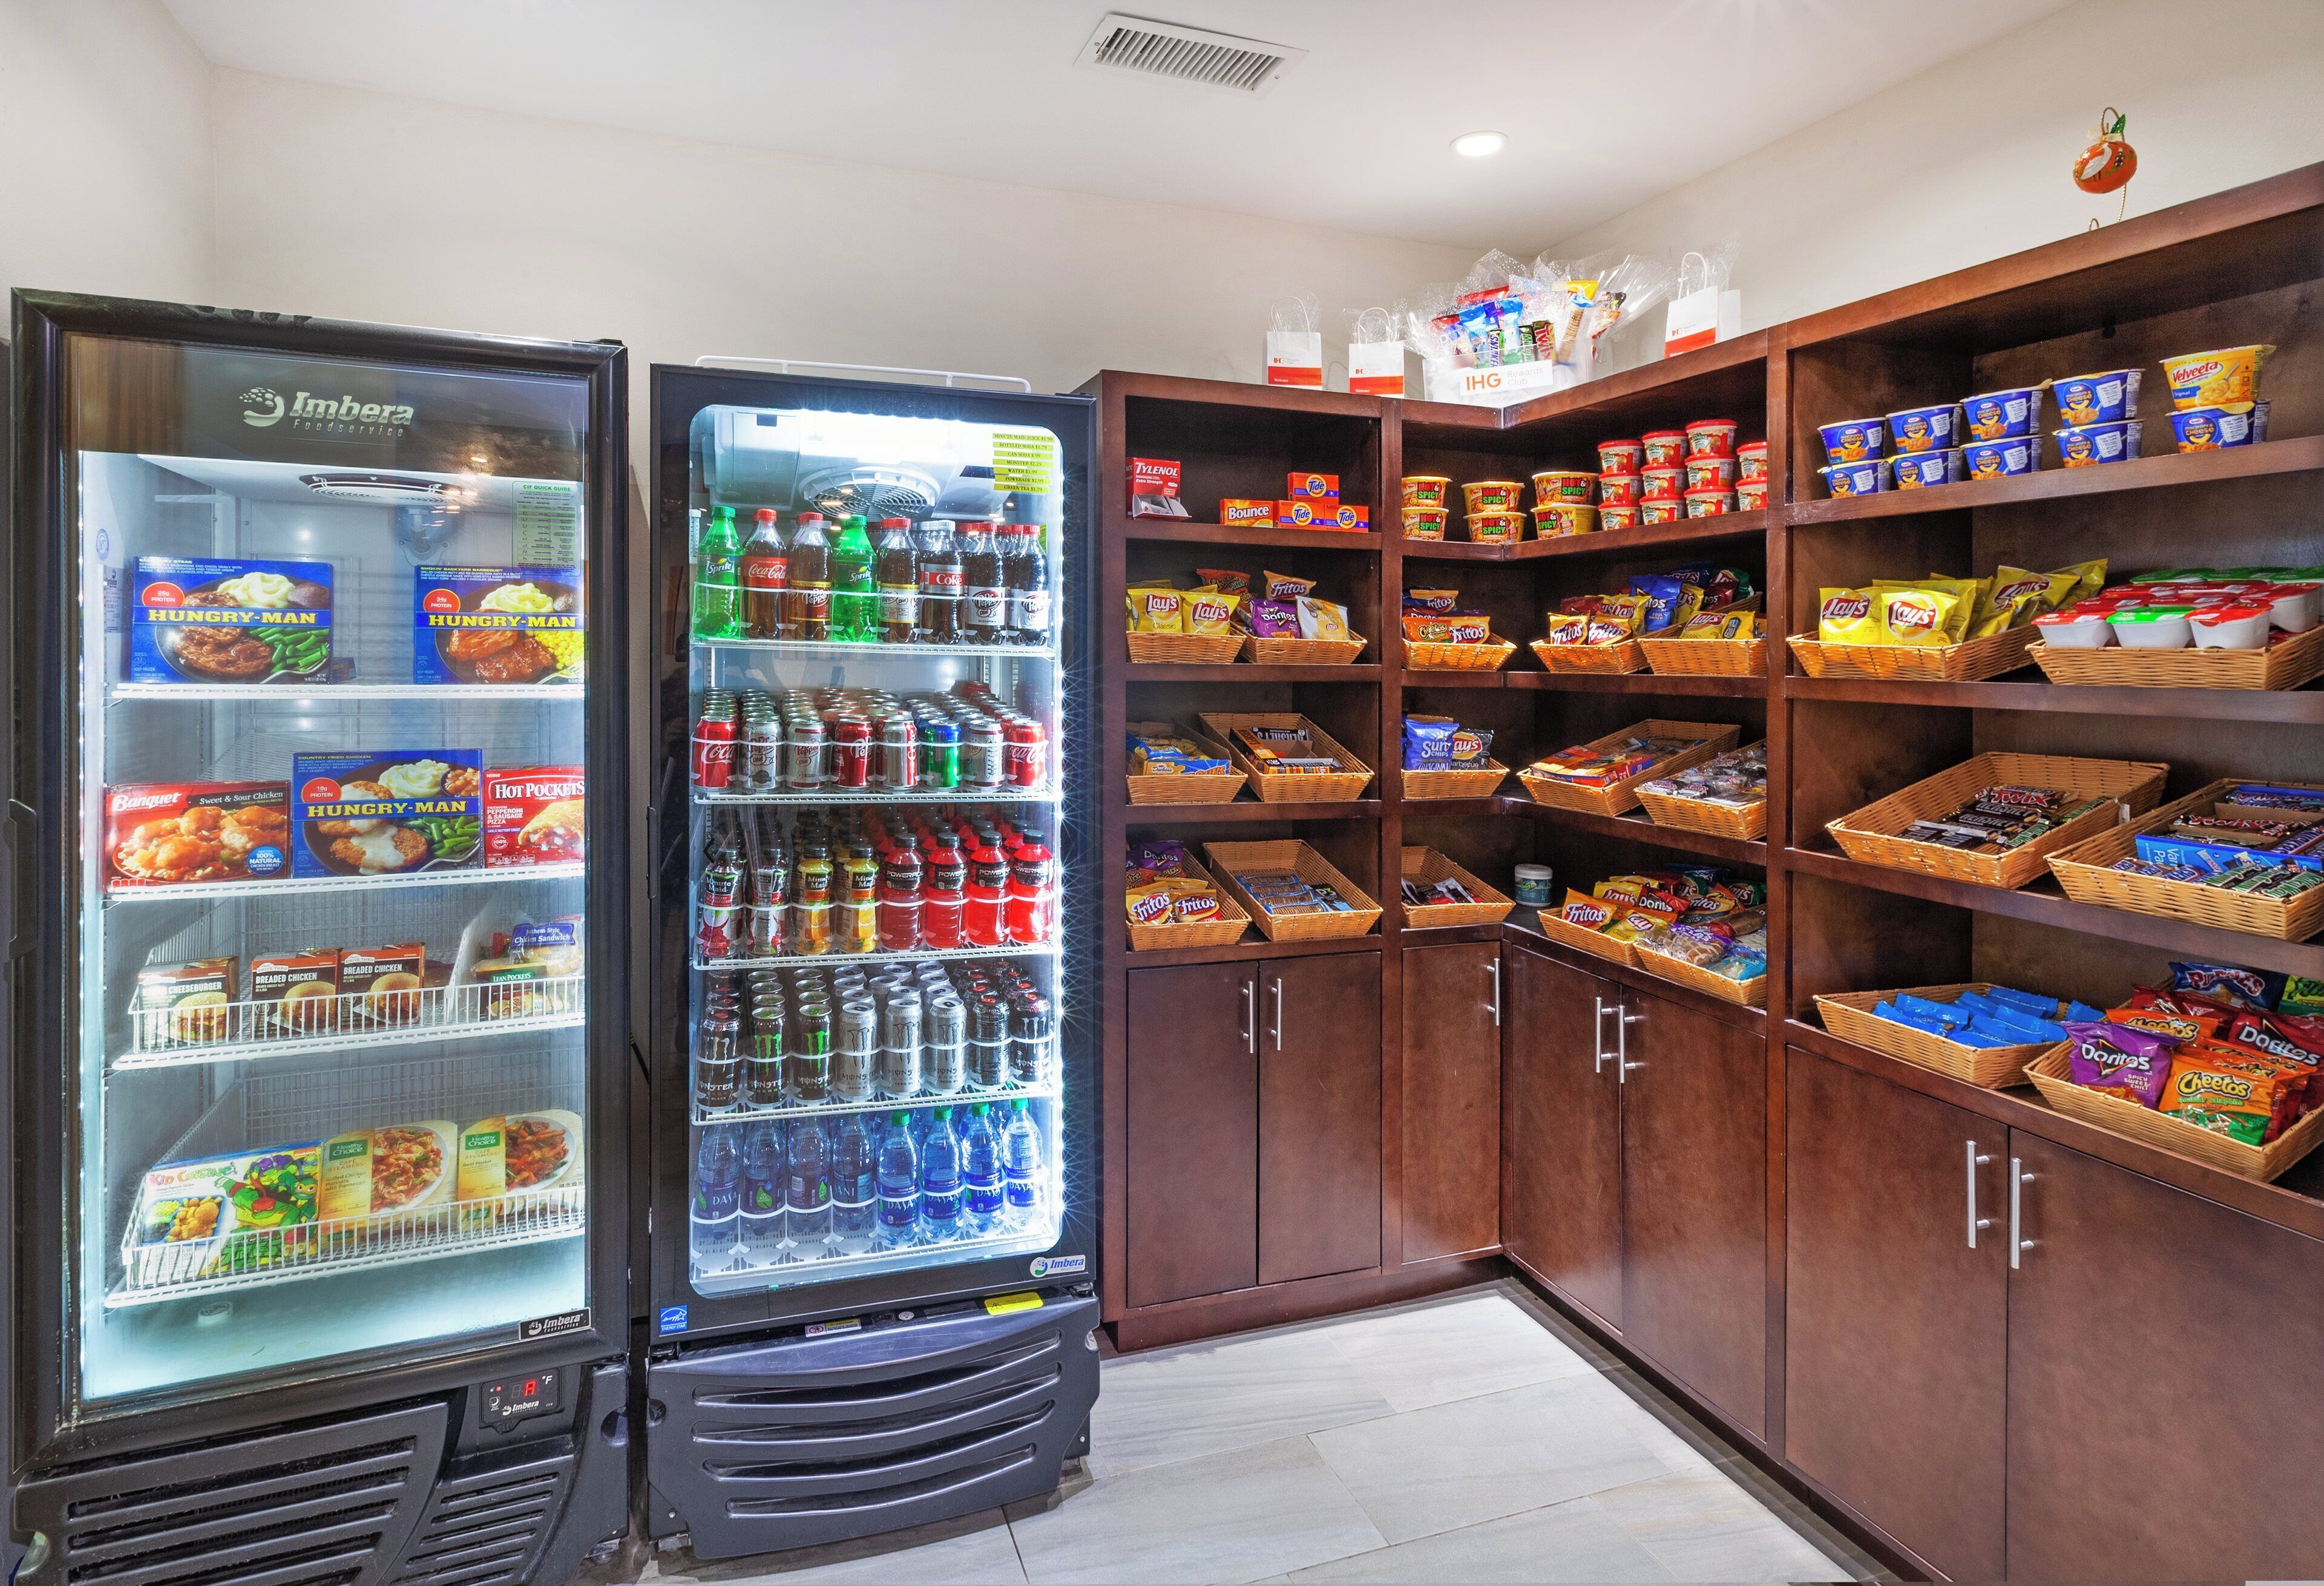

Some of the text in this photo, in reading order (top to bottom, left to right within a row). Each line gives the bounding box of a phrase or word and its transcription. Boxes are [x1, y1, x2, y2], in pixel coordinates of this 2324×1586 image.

[1535, 325, 1551, 361] TWIX
[1466, 367, 1544, 391] IHG Rewards
[2173, 362, 2218, 382] Velveeta
[1507, 378, 1528, 387] Club
[289, 392, 414, 425] Imbera
[294, 419, 403, 437] Foodservice
[1135, 462, 1178, 476] TYLENOL
[1308, 480, 1325, 492] Tide
[1417, 482, 1434, 491] HOT
[1562, 477, 1580, 488] HOT
[1417, 491, 1439, 499] SPICY
[1483, 488, 1500, 496] HOT
[1483, 496, 1506, 504] SPICY
[1229, 506, 1270, 520] Bounce
[1294, 508, 1311, 520] Tide
[1339, 512, 1354, 523] Tide
[1420, 514, 1436, 523] HOT
[1420, 522, 1440, 531] SPICY
[1483, 518, 1499, 526] HOT
[708, 563, 732, 573] Sprite
[749, 564, 785, 578] Coca-Cola
[850, 571, 871, 582] Sprite
[936, 574, 962, 585] Coke
[1271, 582, 1306, 597] Fritos
[1147, 594, 1179, 612] Lay's
[1825, 597, 1868, 618] Lay's
[149, 609, 316, 624] HUNGRY-MAN
[1195, 606, 1227, 621] Lay's
[1261, 611, 1296, 621] Doritos
[1689, 614, 1724, 626] Lay's
[1891, 603, 1936, 625] Lay's
[429, 615, 576, 628] HUNGRY-MAN
[1419, 623, 1446, 637] Cheetos
[1449, 626, 1484, 643] Fritos
[1552, 624, 1583, 644] Fritos
[1825, 632, 1854, 641] Classic
[1422, 741, 1449, 758] Sun
[495, 781, 585, 799] HOT POCKETS
[112, 792, 182, 811] Banquet
[1991, 791, 2050, 805] TWIX
[308, 801, 467, 817] HUNGRY-MAN
[1132, 893, 1170, 921] Fritos
[1175, 896, 1216, 914] Fritos
[1639, 897, 1673, 913] Doritos
[1564, 903, 1606, 922] Fritos
[344, 964, 402, 974] BREADED CHICKEN
[255, 973, 317, 984] BREADED CHICKEN
[169, 982, 222, 994] CHEESEBURGER
[2240, 1026, 2321, 1064] Doritos
[2081, 1043, 2152, 1070] Doritos
[2177, 1070, 2251, 1099] Cheetos
[1051, 1258, 1085, 1268] Imbera
[543, 1314, 580, 1329] Imbera
[513, 1401, 539, 1411] Imbera
